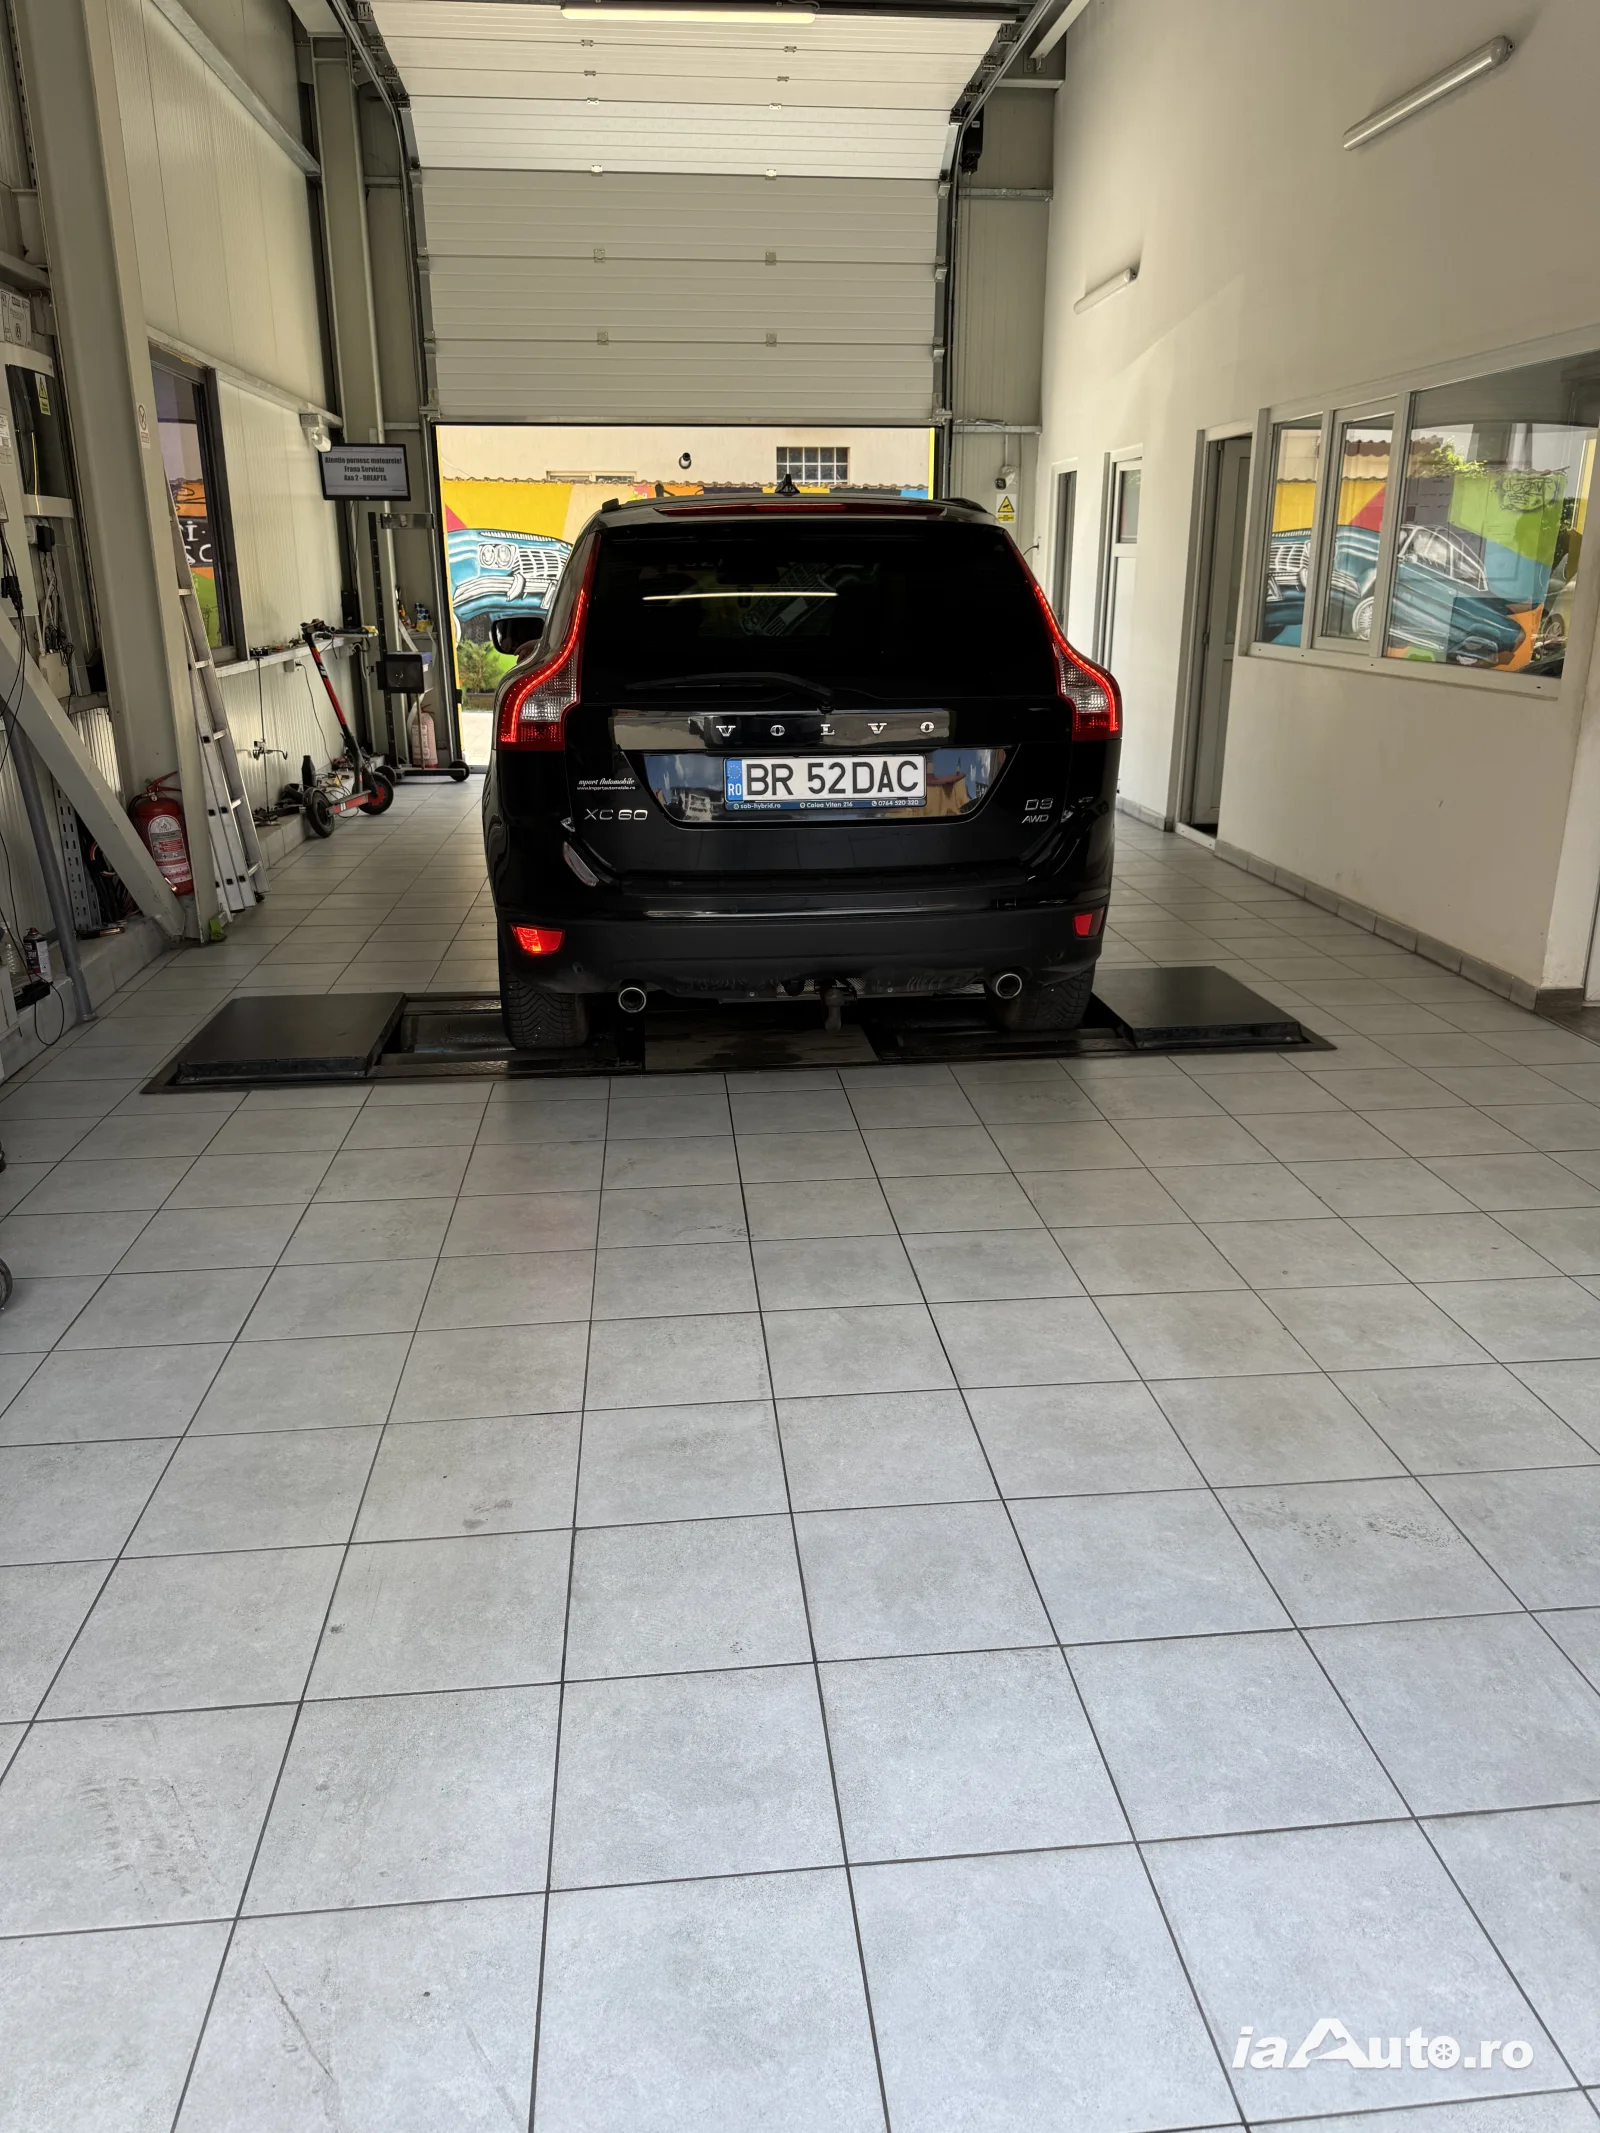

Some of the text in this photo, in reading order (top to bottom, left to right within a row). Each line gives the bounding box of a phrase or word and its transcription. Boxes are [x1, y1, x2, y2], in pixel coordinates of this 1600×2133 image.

[716, 721, 935, 737] VOLVO
[746, 760, 918, 796] BR 52DAC
[728, 783, 742, 796] RO
[1022, 814, 1050, 824] AWD
